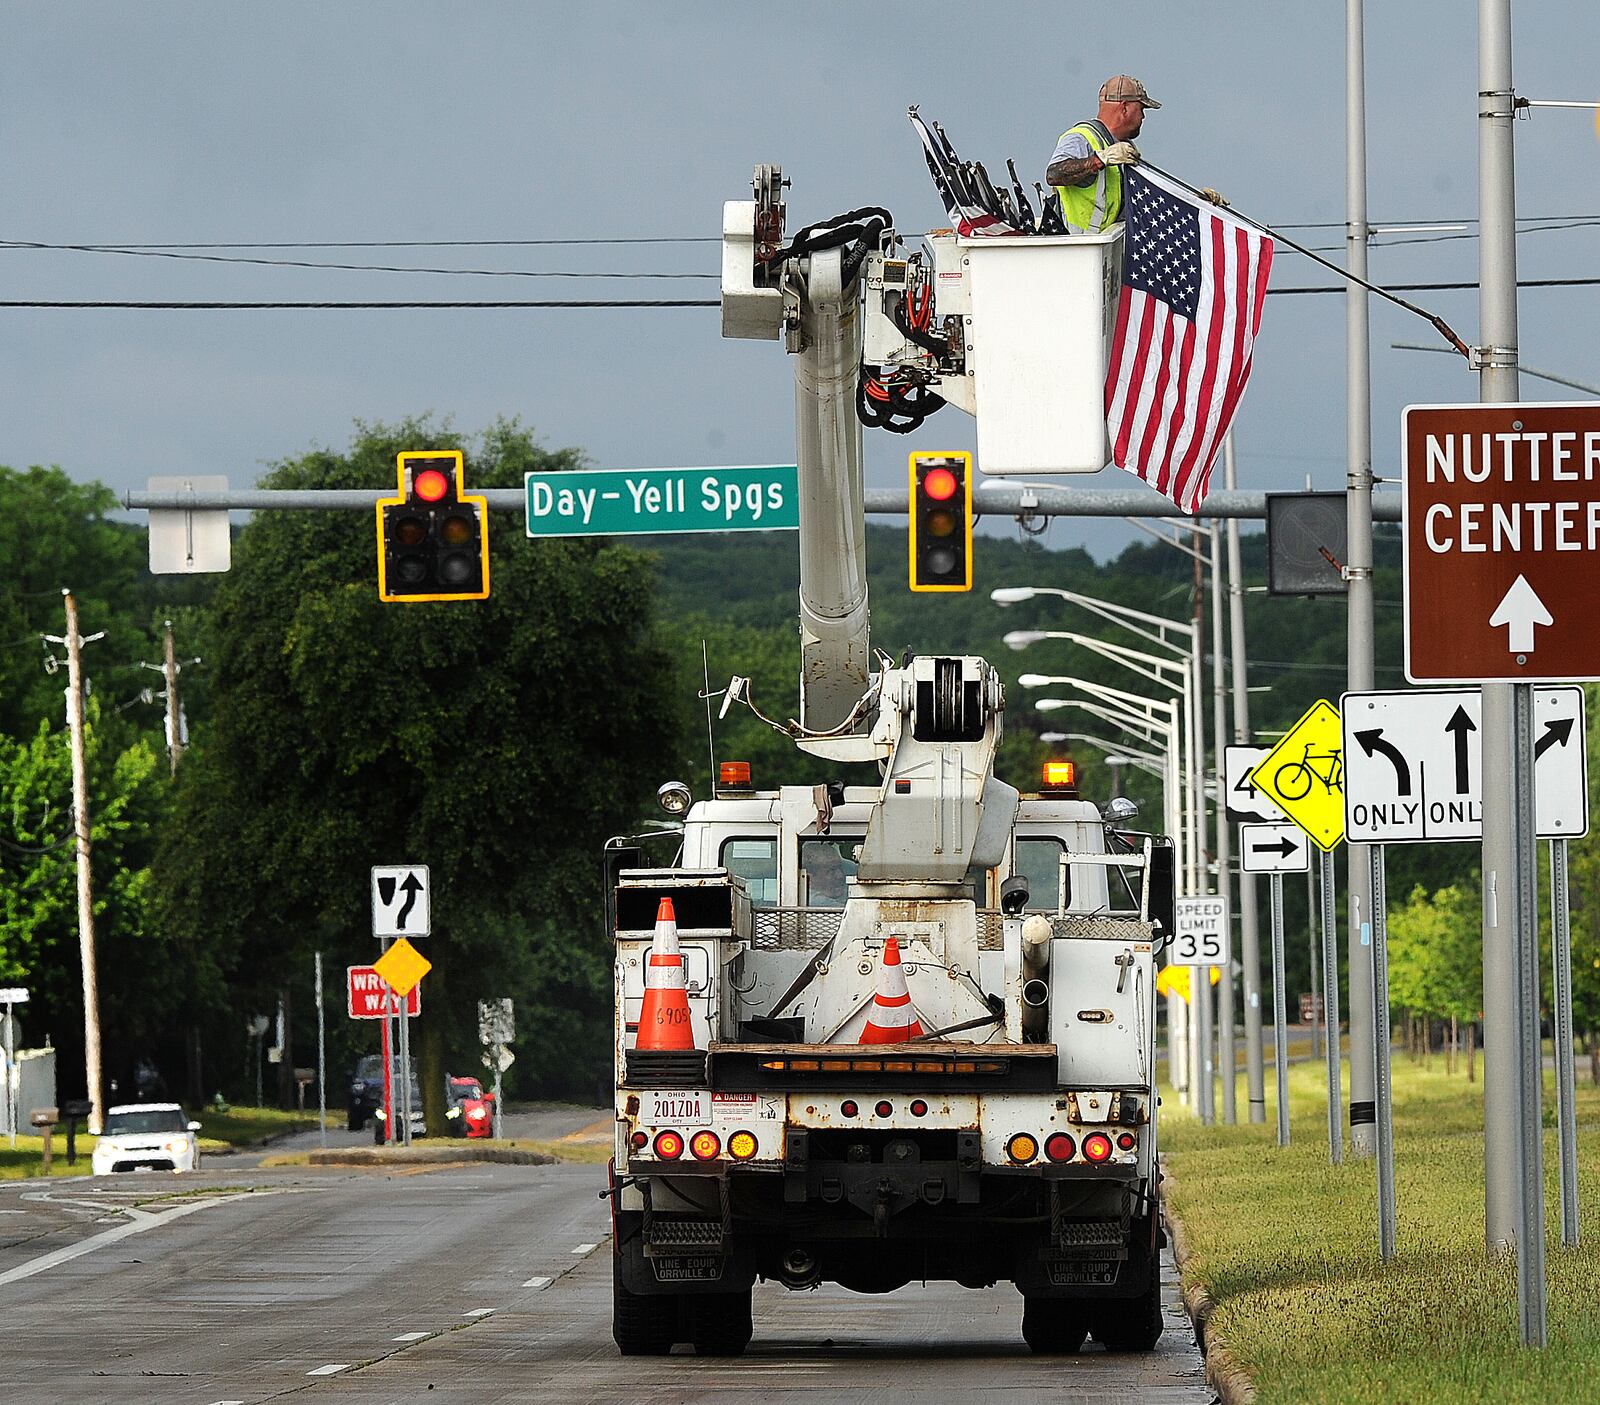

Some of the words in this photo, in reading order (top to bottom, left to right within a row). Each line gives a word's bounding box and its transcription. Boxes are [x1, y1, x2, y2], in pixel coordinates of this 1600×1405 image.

[1425, 431, 1600, 483] NUTTER
[532, 477, 685, 525] Day-Yell
[701, 475, 784, 521] Spgs
[1353, 802, 1420, 826] ONLY
[1430, 801, 1482, 824] ONL
[1176, 904, 1223, 916] SPEED
[1180, 919, 1217, 931] LIMIT
[1180, 934, 1220, 958] 35
[352, 973, 386, 991] WRO
[364, 993, 402, 1011] WAY
[723, 1093, 753, 1101] DANGER
[654, 1100, 701, 1118] 201ZDA
[659, 1258, 681, 1268] LINE
[1054, 1263, 1075, 1273] LINE
